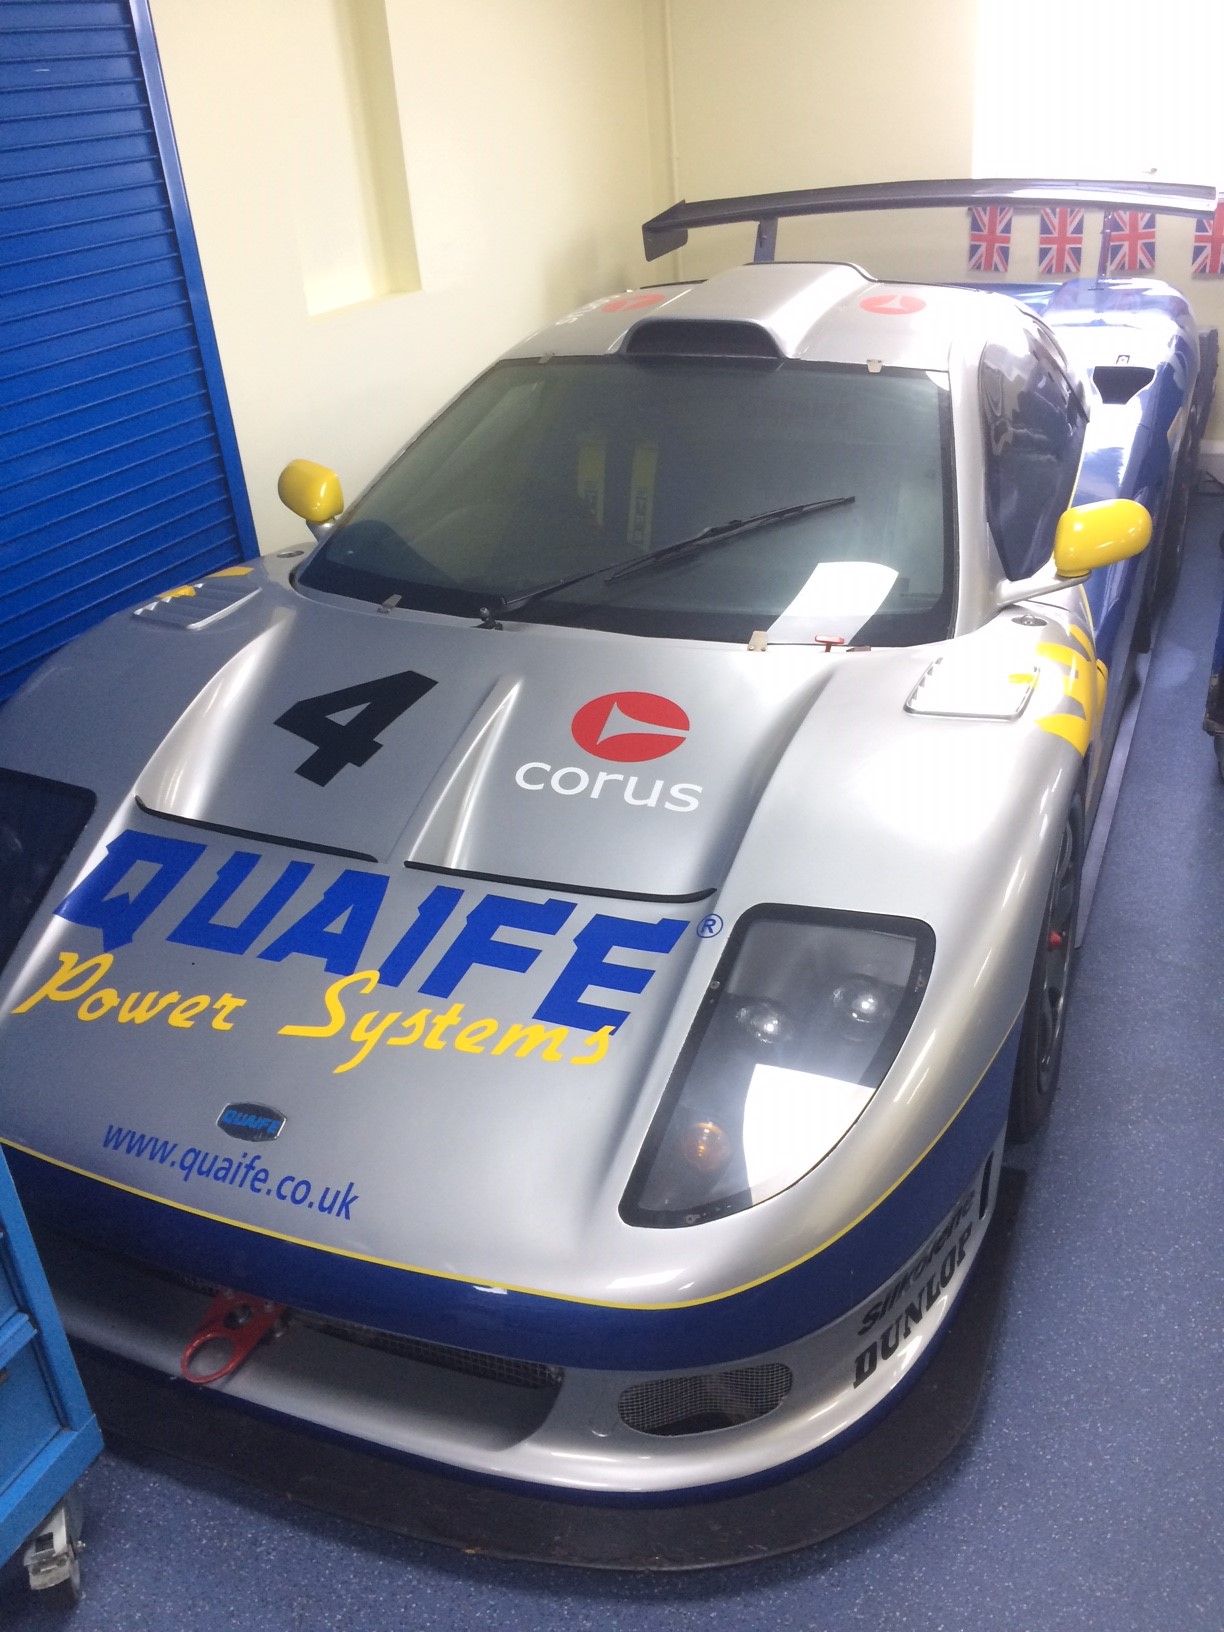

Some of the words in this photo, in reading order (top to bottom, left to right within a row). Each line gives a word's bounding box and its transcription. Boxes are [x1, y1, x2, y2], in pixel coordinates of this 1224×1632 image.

[273, 670, 438, 788] 4
[515, 761, 703, 812] corus
[53, 829, 691, 1036] QUAIFE
[12, 951, 247, 1031] Power
[278, 970, 618, 1074] Systems
[102, 1124, 359, 1221] www.quaife.co.uk
[221, 1109, 282, 1134] QUAIFE
[852, 1222, 973, 1389] DUNLOP
